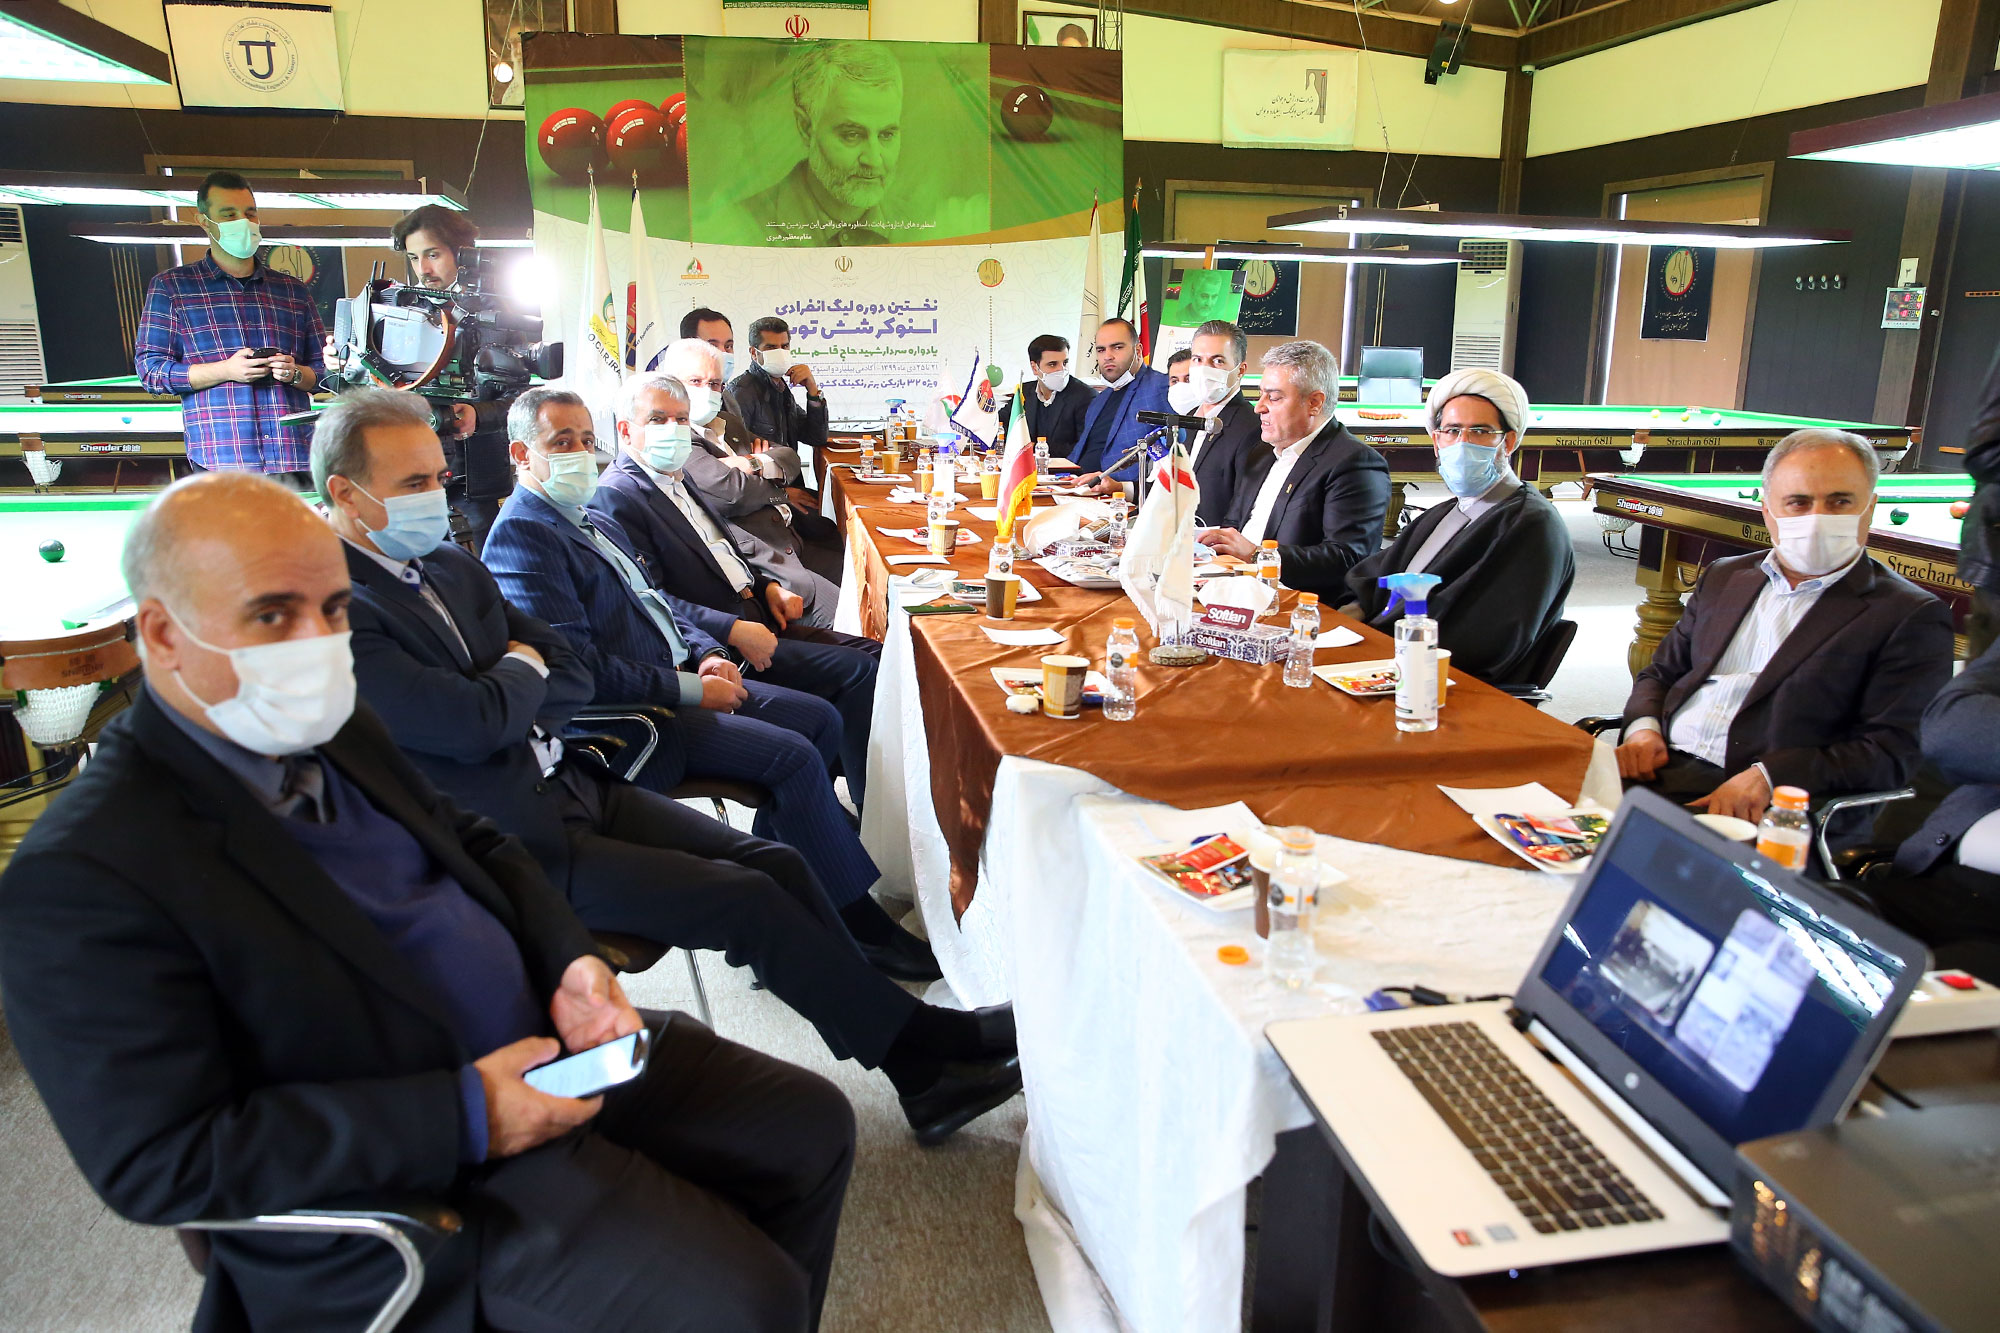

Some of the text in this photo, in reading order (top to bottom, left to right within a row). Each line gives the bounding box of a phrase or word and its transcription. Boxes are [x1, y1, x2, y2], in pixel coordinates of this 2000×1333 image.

[1338, 204, 1348, 220] 5
[810, 220, 820, 229] این
[776, 299, 938, 315] نخستین دوره لیگ انفرادی
[821, 318, 874, 339] شش
[875, 318, 938, 339] اسنوکر
[812, 345, 838, 358] قاسم
[840, 346, 857, 362] حاج
[859, 346, 882, 357] شهید
[882, 346, 907, 356] سردار
[908, 346, 938, 357] یادواره
[881, 379, 906, 388] بازیکن
[922, 380, 938, 388] ویژه
[1555, 436, 1592, 446] Strachan
[1666, 436, 1701, 446] Strachan
[80, 444, 122, 452] Shender
[1616, 498, 1648, 512] Shender
[1888, 555, 1956, 586] Strachan
[1208, 607, 1246, 624] Softlan
[1197, 634, 1226, 649] Softlan
